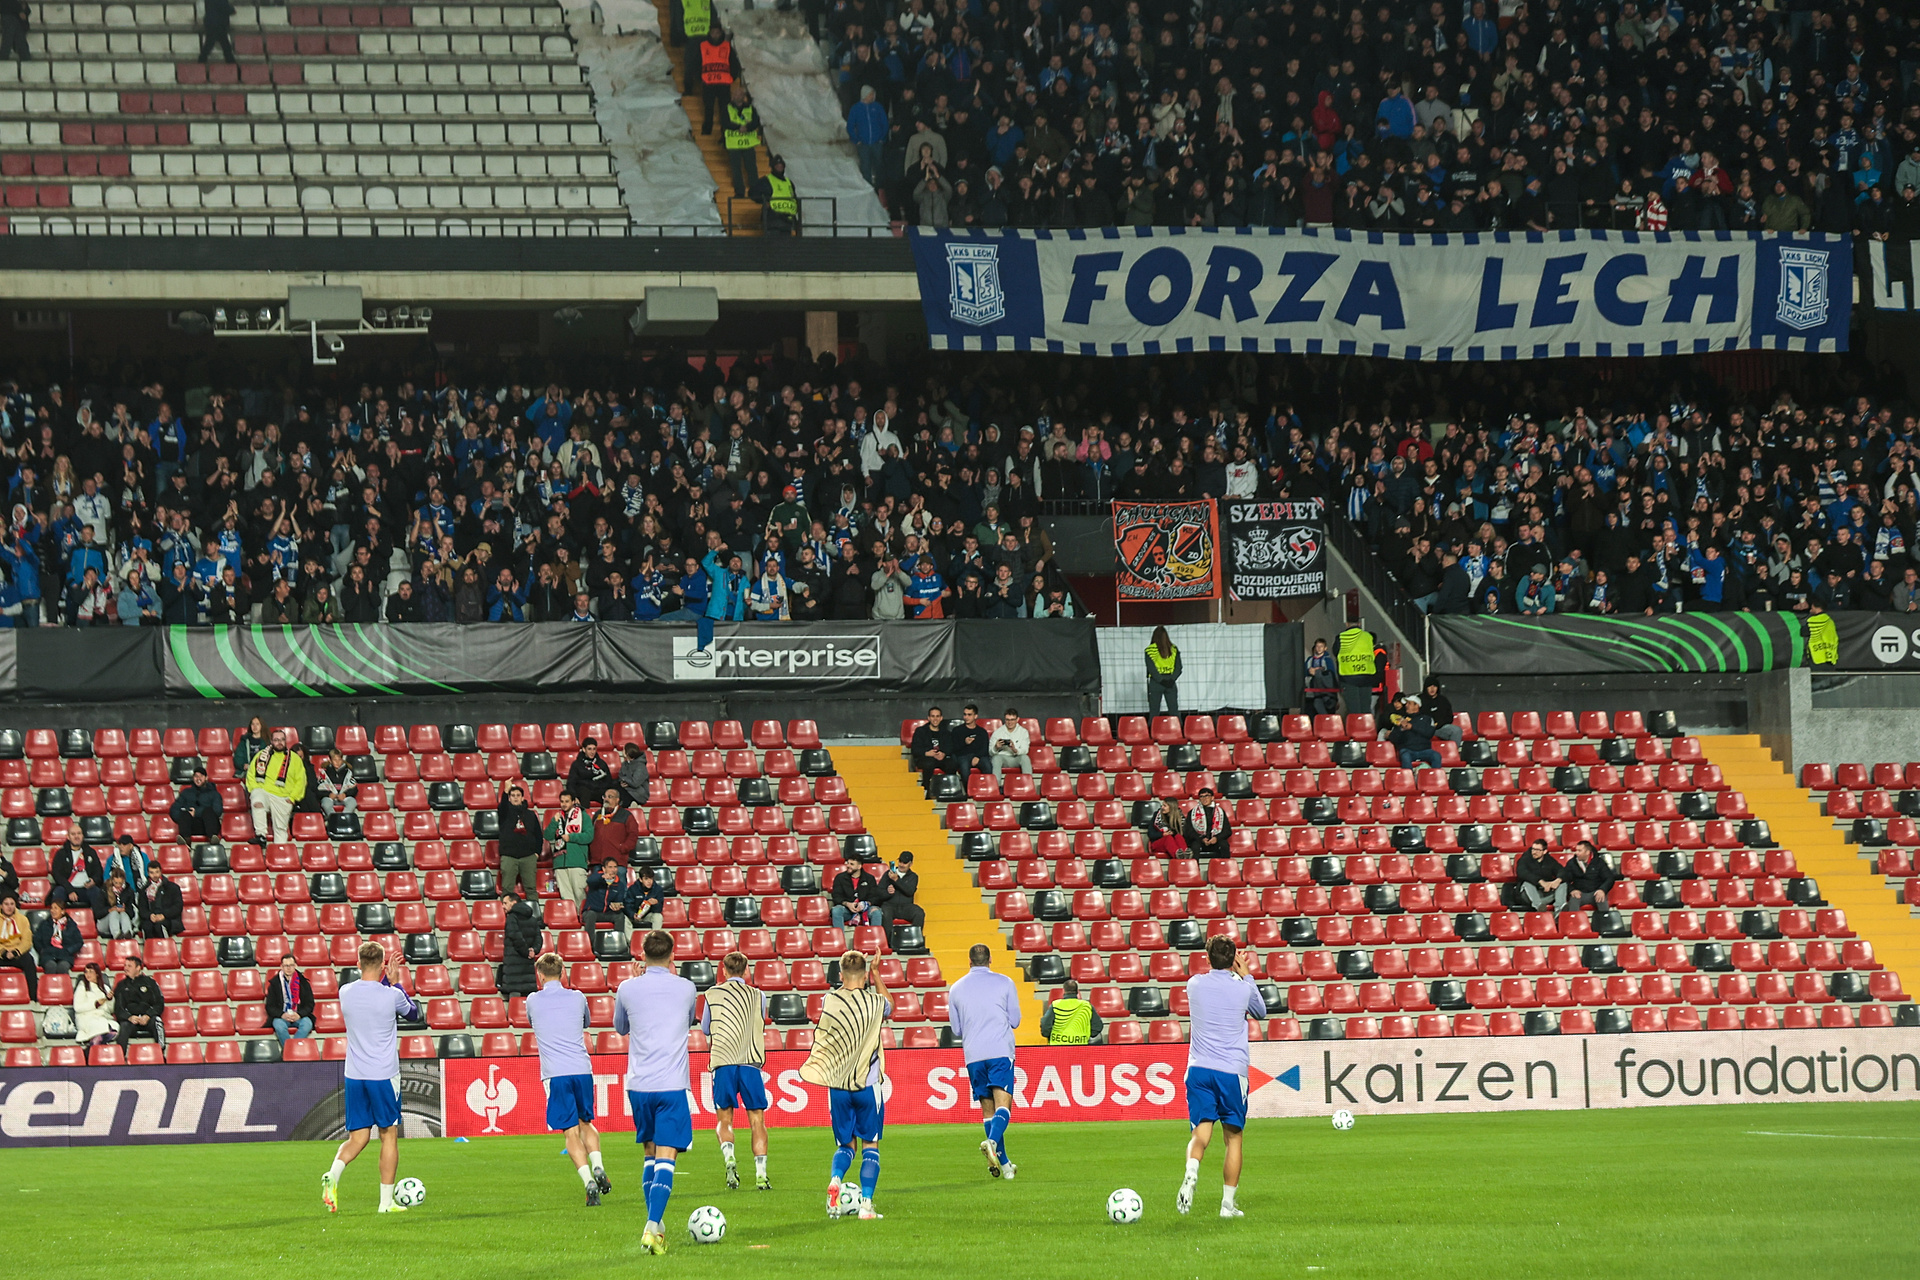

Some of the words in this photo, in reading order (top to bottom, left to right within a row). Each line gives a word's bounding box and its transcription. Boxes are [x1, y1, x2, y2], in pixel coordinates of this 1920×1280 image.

[954, 249, 969, 257] KKS
[973, 249, 992, 257] LECH
[1786, 252, 1801, 261] KKS
[1805, 254, 1823, 263] LECH
[1063, 245, 1406, 330] FORZA
[1475, 252, 1740, 333] LECH
[1115, 503, 1210, 525] CHULIGANI
[1230, 502, 1319, 523] SZEPIET
[1132, 541, 1148, 567] GROUP
[1176, 565, 1194, 573] 1929
[1233, 571, 1324, 586] POZDROWIENIA
[1238, 586, 1254, 596] DO
[686, 643, 877, 673] enterprise
[1340, 655, 1374, 663] SECURIT
[1051, 1033, 1087, 1044] SECURIT
[1324, 1048, 1558, 1103] kaizen
[1615, 1045, 1920, 1098] foundation
[0, 1077, 278, 1137] enn
